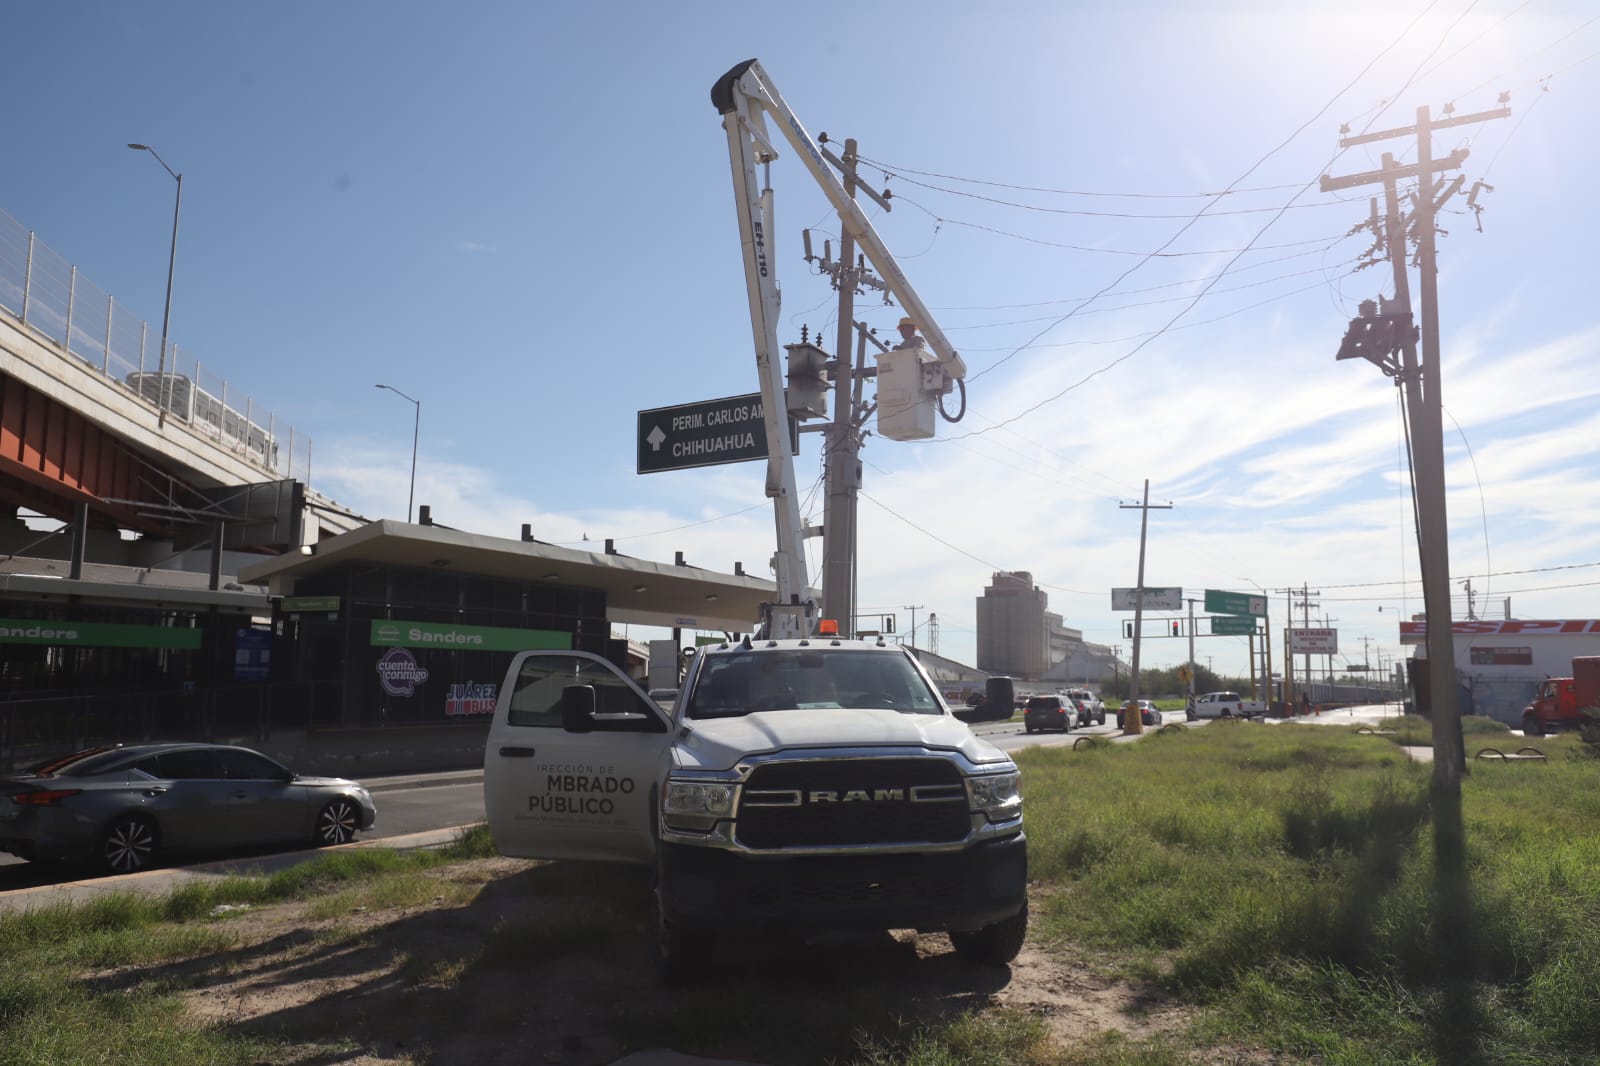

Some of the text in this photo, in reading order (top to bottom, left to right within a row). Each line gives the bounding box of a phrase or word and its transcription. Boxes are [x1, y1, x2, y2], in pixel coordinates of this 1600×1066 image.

[672, 413, 705, 431] PERIM.
[707, 405, 748, 426] CARLOS
[672, 432, 755, 457] CHIHUAHUA
[408, 628, 483, 645] Sanders
[378, 659, 415, 671] cuenta
[384, 670, 427, 682] conmigo
[447, 680, 497, 699] JUÁREZ
[471, 700, 497, 713] BUS
[599, 765, 616, 775] DE
[809, 788, 904, 802] RAM
[528, 792, 614, 815] PÚBLICO
